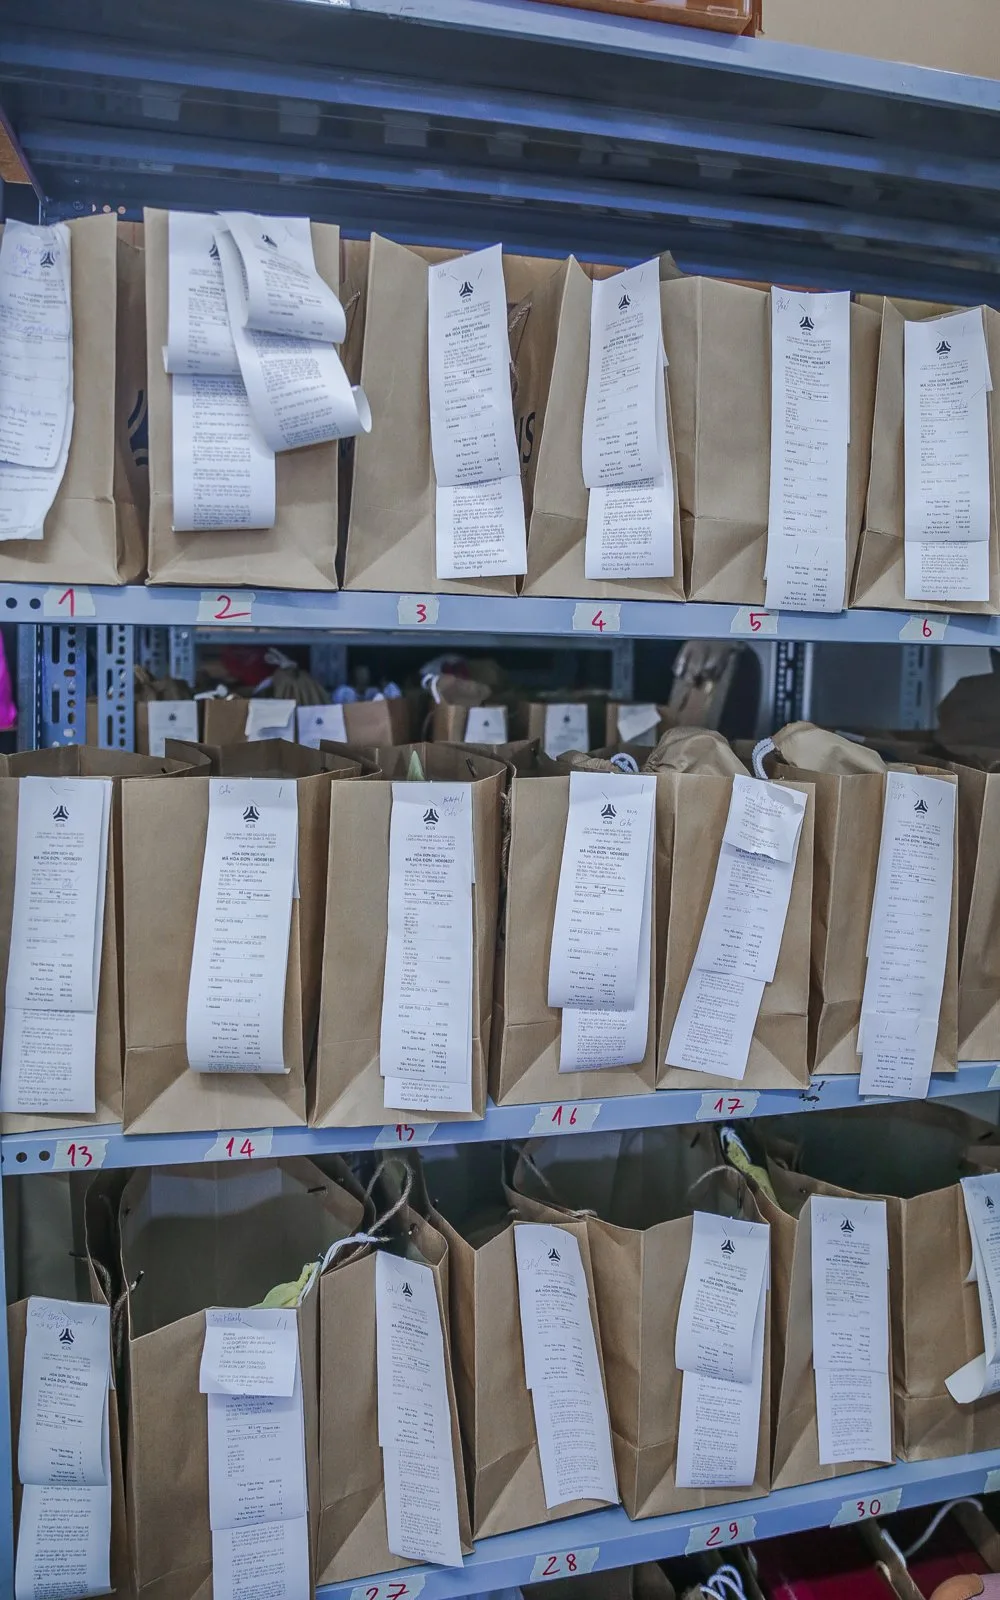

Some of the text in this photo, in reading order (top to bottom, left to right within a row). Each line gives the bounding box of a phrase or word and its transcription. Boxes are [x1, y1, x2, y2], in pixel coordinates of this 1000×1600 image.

[58, 589, 75, 616] 1
[215, 596, 251, 619] 2
[416, 602, 427, 621] 3
[591, 611, 606, 631] 4
[749, 612, 770, 632] 5
[922, 622, 933, 638] 6
[552, 1106, 577, 1125] 16
[714, 1097, 744, 1114] 17
[396, 1123, 415, 1142] 15
[67, 1143, 93, 1167] 13
[226, 1138, 256, 1158] 14
[856, 1500, 881, 1516] 30
[706, 1522, 738, 1547] 29
[542, 1553, 580, 1575] 28
